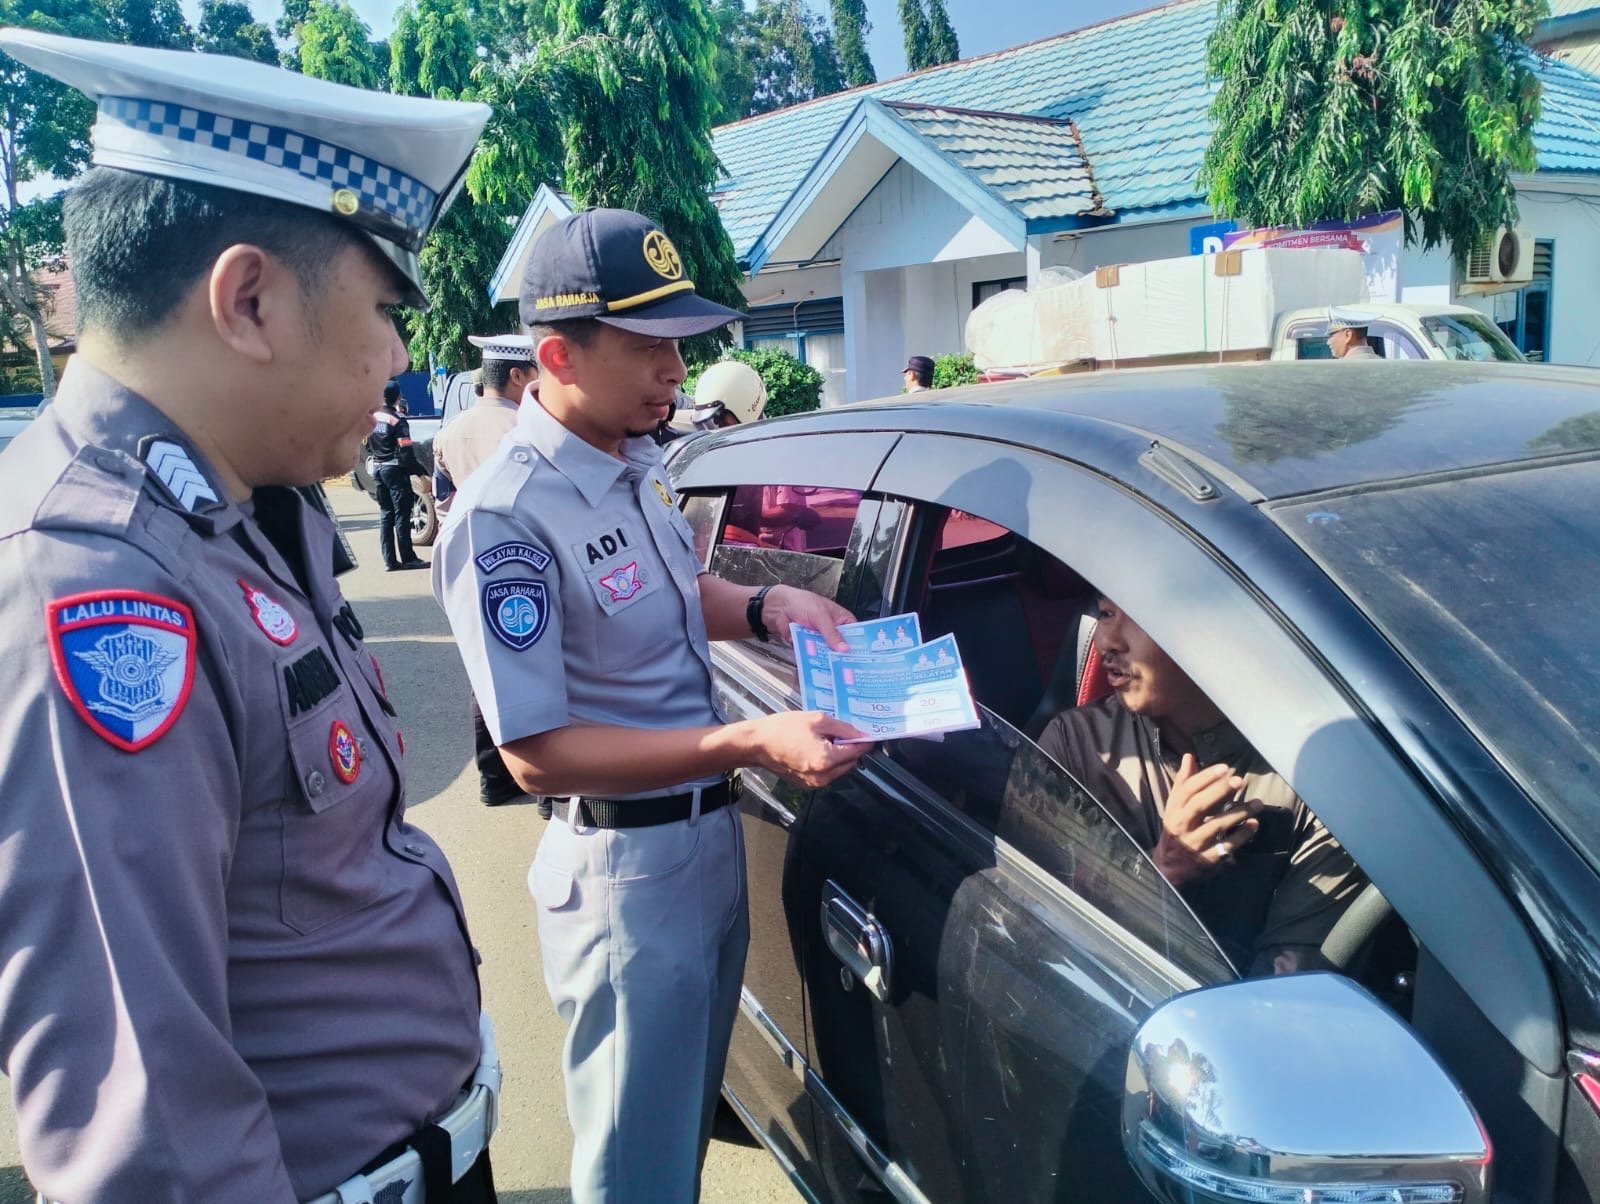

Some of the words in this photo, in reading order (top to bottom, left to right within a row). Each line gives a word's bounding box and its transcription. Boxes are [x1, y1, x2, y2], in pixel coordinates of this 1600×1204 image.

[1310, 234, 1348, 243] BERSAMA
[556, 292, 600, 307] RAHARJA
[586, 528, 628, 565] ADI
[483, 548, 516, 566] WILAYAH
[518, 548, 543, 566] KALSEL
[489, 587, 509, 599] JASA
[510, 586, 542, 599] RAHARJA
[63, 600, 114, 623] LALU
[121, 600, 182, 626] LINTAS
